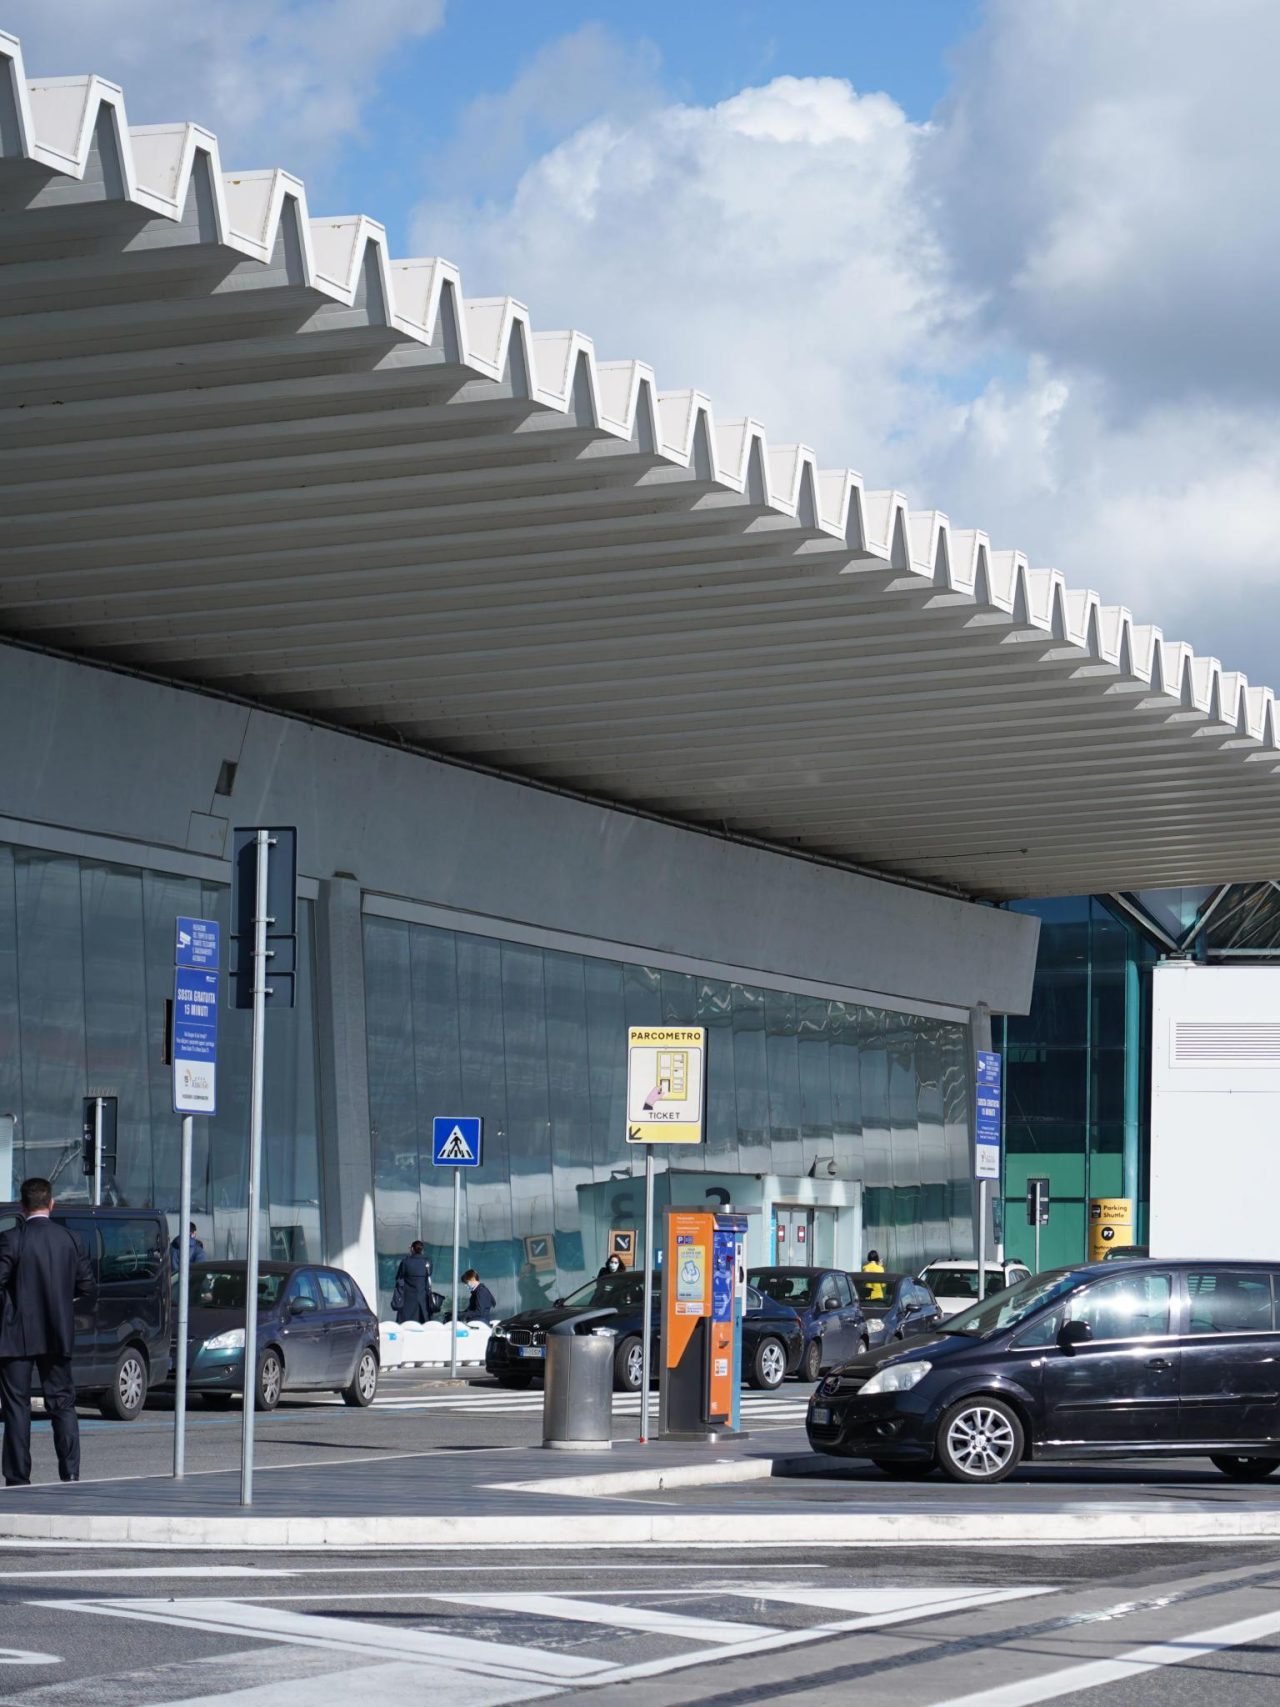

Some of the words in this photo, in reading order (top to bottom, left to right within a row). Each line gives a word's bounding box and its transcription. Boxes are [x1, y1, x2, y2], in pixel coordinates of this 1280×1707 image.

[178, 988, 193, 1001] SOSTA
[184, 1004, 190, 1015] 15
[631, 1032, 701, 1040] PARCOMETRO
